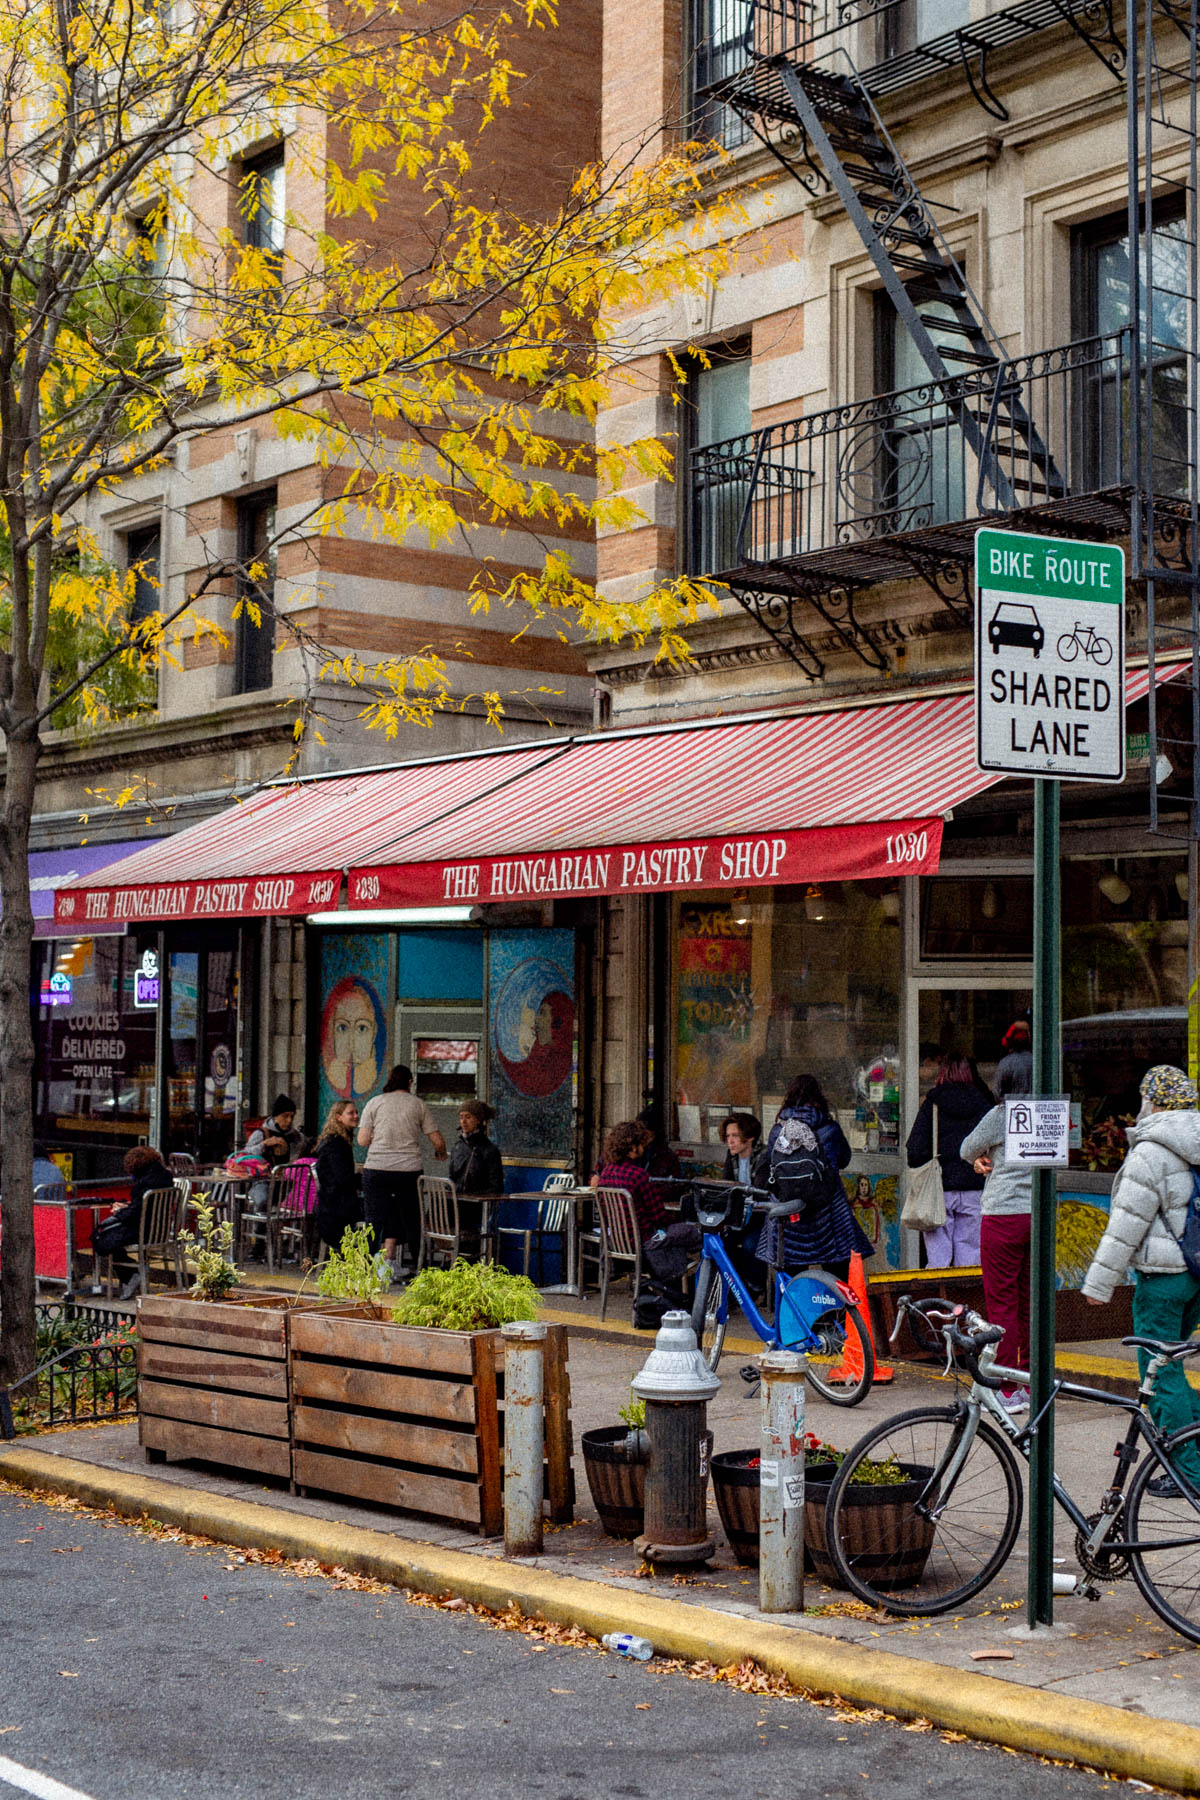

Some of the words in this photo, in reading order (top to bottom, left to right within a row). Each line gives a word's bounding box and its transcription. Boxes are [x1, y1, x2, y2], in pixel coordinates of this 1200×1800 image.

[990, 549, 1034, 579] BIKE
[1045, 556, 1111, 588] ROUTE
[990, 669, 1111, 712] SHARED
[1011, 718, 1090, 757] LANE
[355, 876, 380, 900] 1030
[443, 864, 480, 899] THE
[490, 854, 611, 896] HUNGARIAN
[620, 846, 708, 888] PASTRY
[720, 839, 787, 880] SHOP
[885, 831, 928, 864] 1030
[85, 892, 110, 919] THE
[113, 887, 189, 918] HUNGARIAN
[193, 883, 248, 913] PASTRY
[252, 880, 294, 910] SHOP
[68, 1011, 120, 1031] COOKIES
[62, 1039, 126, 1060] DELIVERED
[72, 1065, 93, 1077] OPEN
[94, 1065, 113, 1078] LATE
